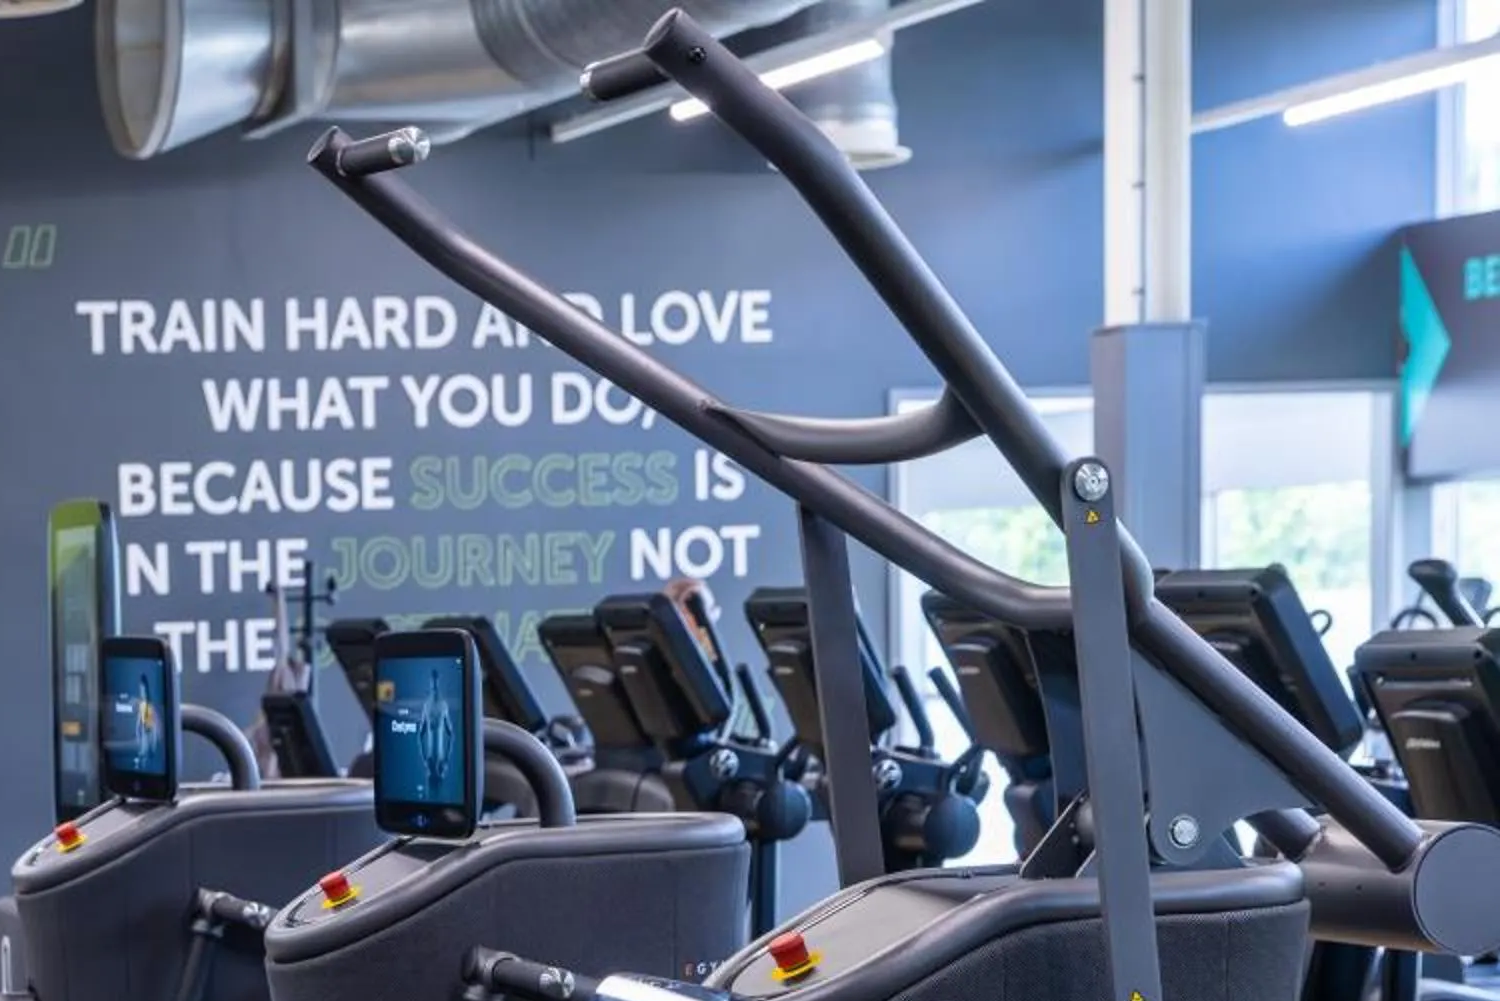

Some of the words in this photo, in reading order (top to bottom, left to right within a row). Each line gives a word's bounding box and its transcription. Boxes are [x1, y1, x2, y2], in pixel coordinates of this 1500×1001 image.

[76, 298, 265, 355] TRAIN
[285, 296, 458, 351] HARD
[620, 290, 774, 346] LOVE
[202, 377, 389, 432] WHAT
[400, 373, 533, 429] YOU
[118, 457, 395, 517] BECAUSE
[409, 451, 679, 511] SUCCESS
[694, 449, 746, 501] IS
[126, 541, 170, 596] N
[185, 538, 308, 595] THE
[326, 529, 617, 591] JOURNEY
[630, 524, 761, 581] NOT
[153, 618, 277, 674] THE
